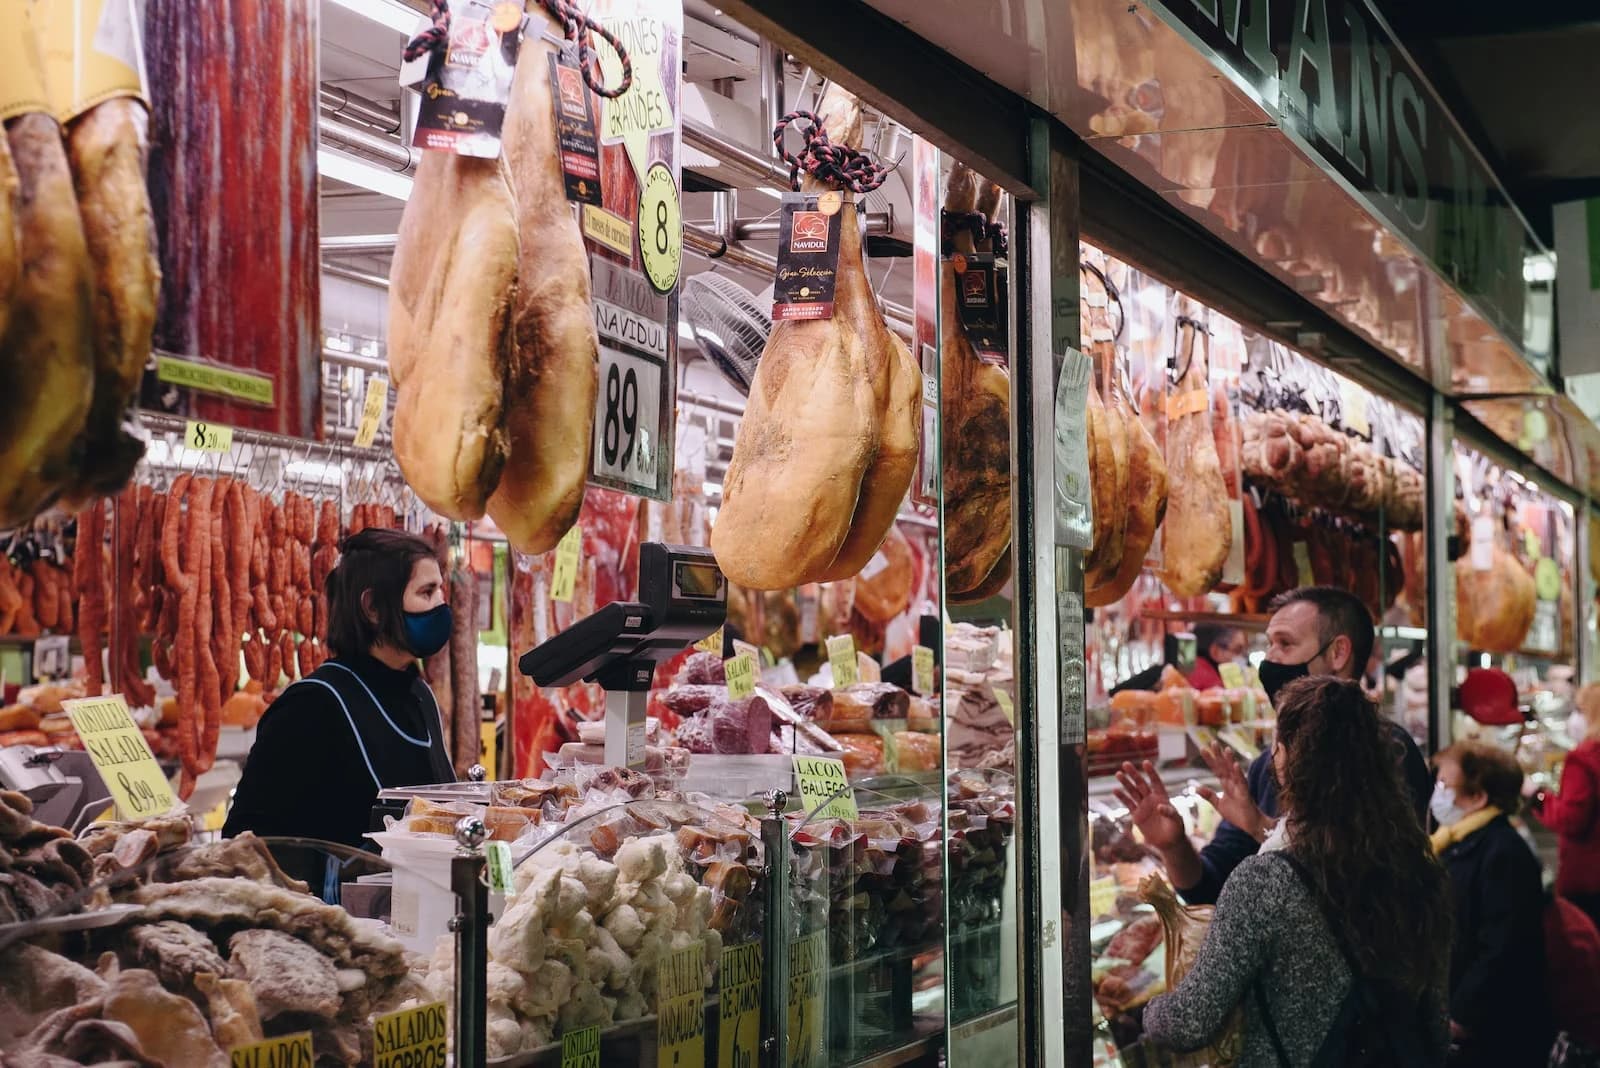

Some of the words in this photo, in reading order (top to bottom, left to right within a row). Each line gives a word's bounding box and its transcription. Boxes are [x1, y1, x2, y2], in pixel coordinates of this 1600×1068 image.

[608, 90, 662, 135] GRANDES
[656, 200, 668, 255] 8
[793, 241, 825, 249] NAVIDUL
[596, 304, 665, 352] NAVIDUL
[604, 362, 638, 473] 89
[87, 735, 152, 767] SALADA
[796, 760, 843, 778] LACON
[721, 943, 761, 990] HUESOS
[722, 988, 733, 1019] DE
[375, 1005, 446, 1054] SALADOS
